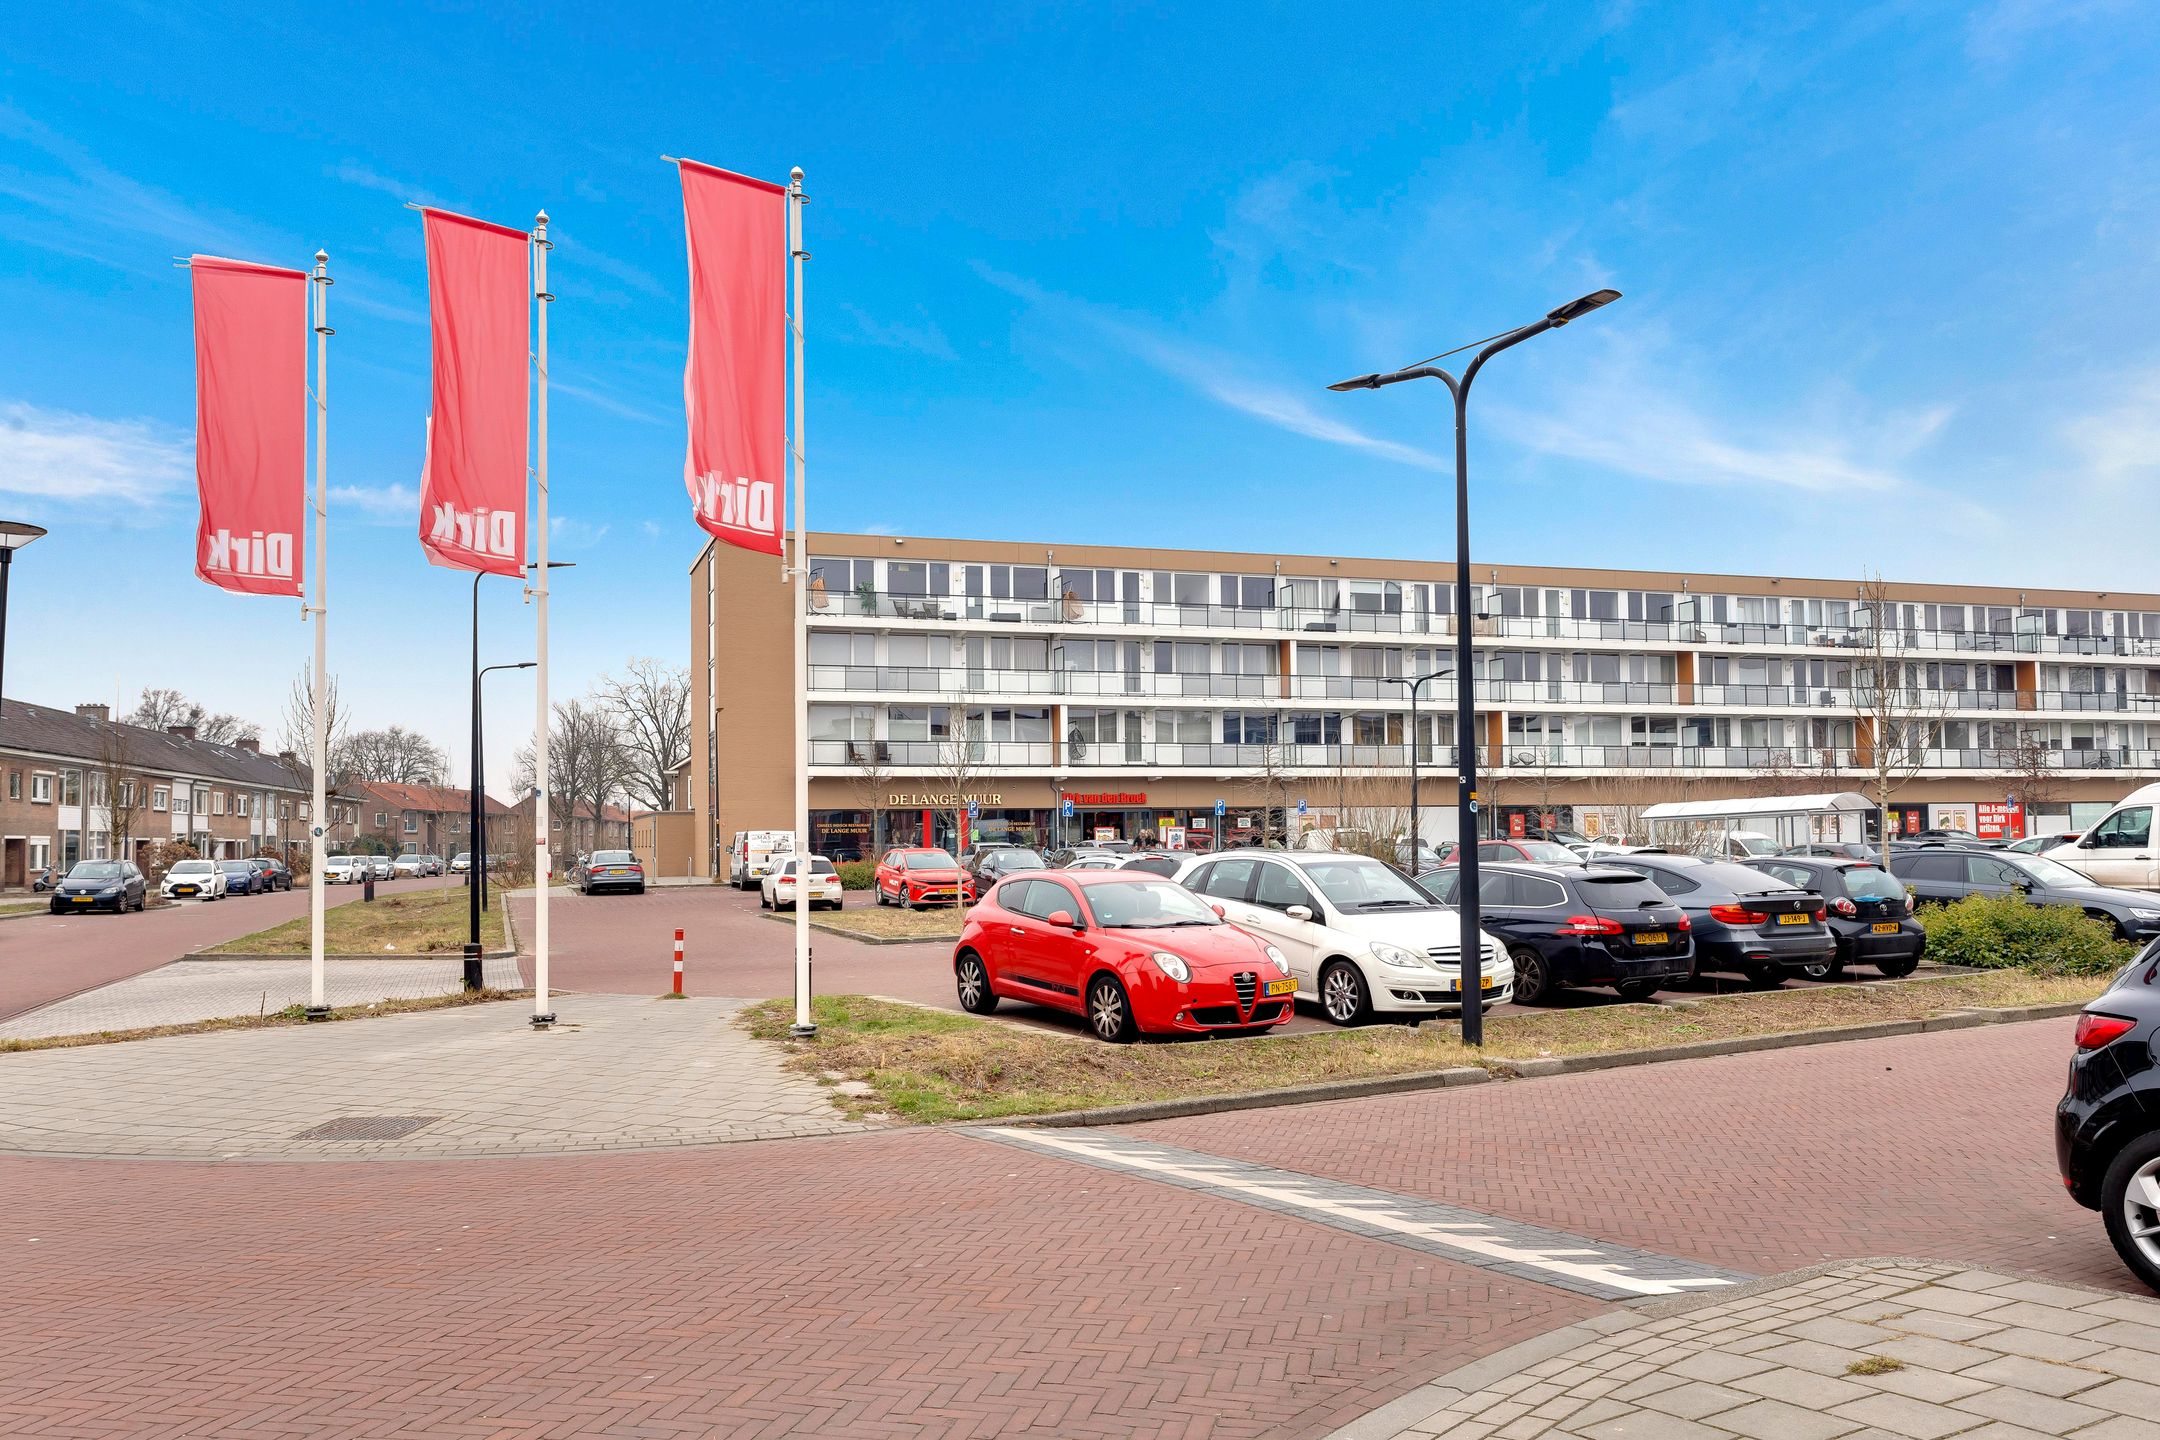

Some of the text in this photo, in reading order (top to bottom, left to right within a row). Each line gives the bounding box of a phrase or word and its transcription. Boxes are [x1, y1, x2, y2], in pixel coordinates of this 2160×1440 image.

[889, 794, 1002, 805] DE LANGE MUUR
[1083, 794, 1099, 804] van
[1101, 793, 1118, 804] den
[1979, 805, 1990, 813] Alle
[1993, 814, 2006, 823] Dirk
